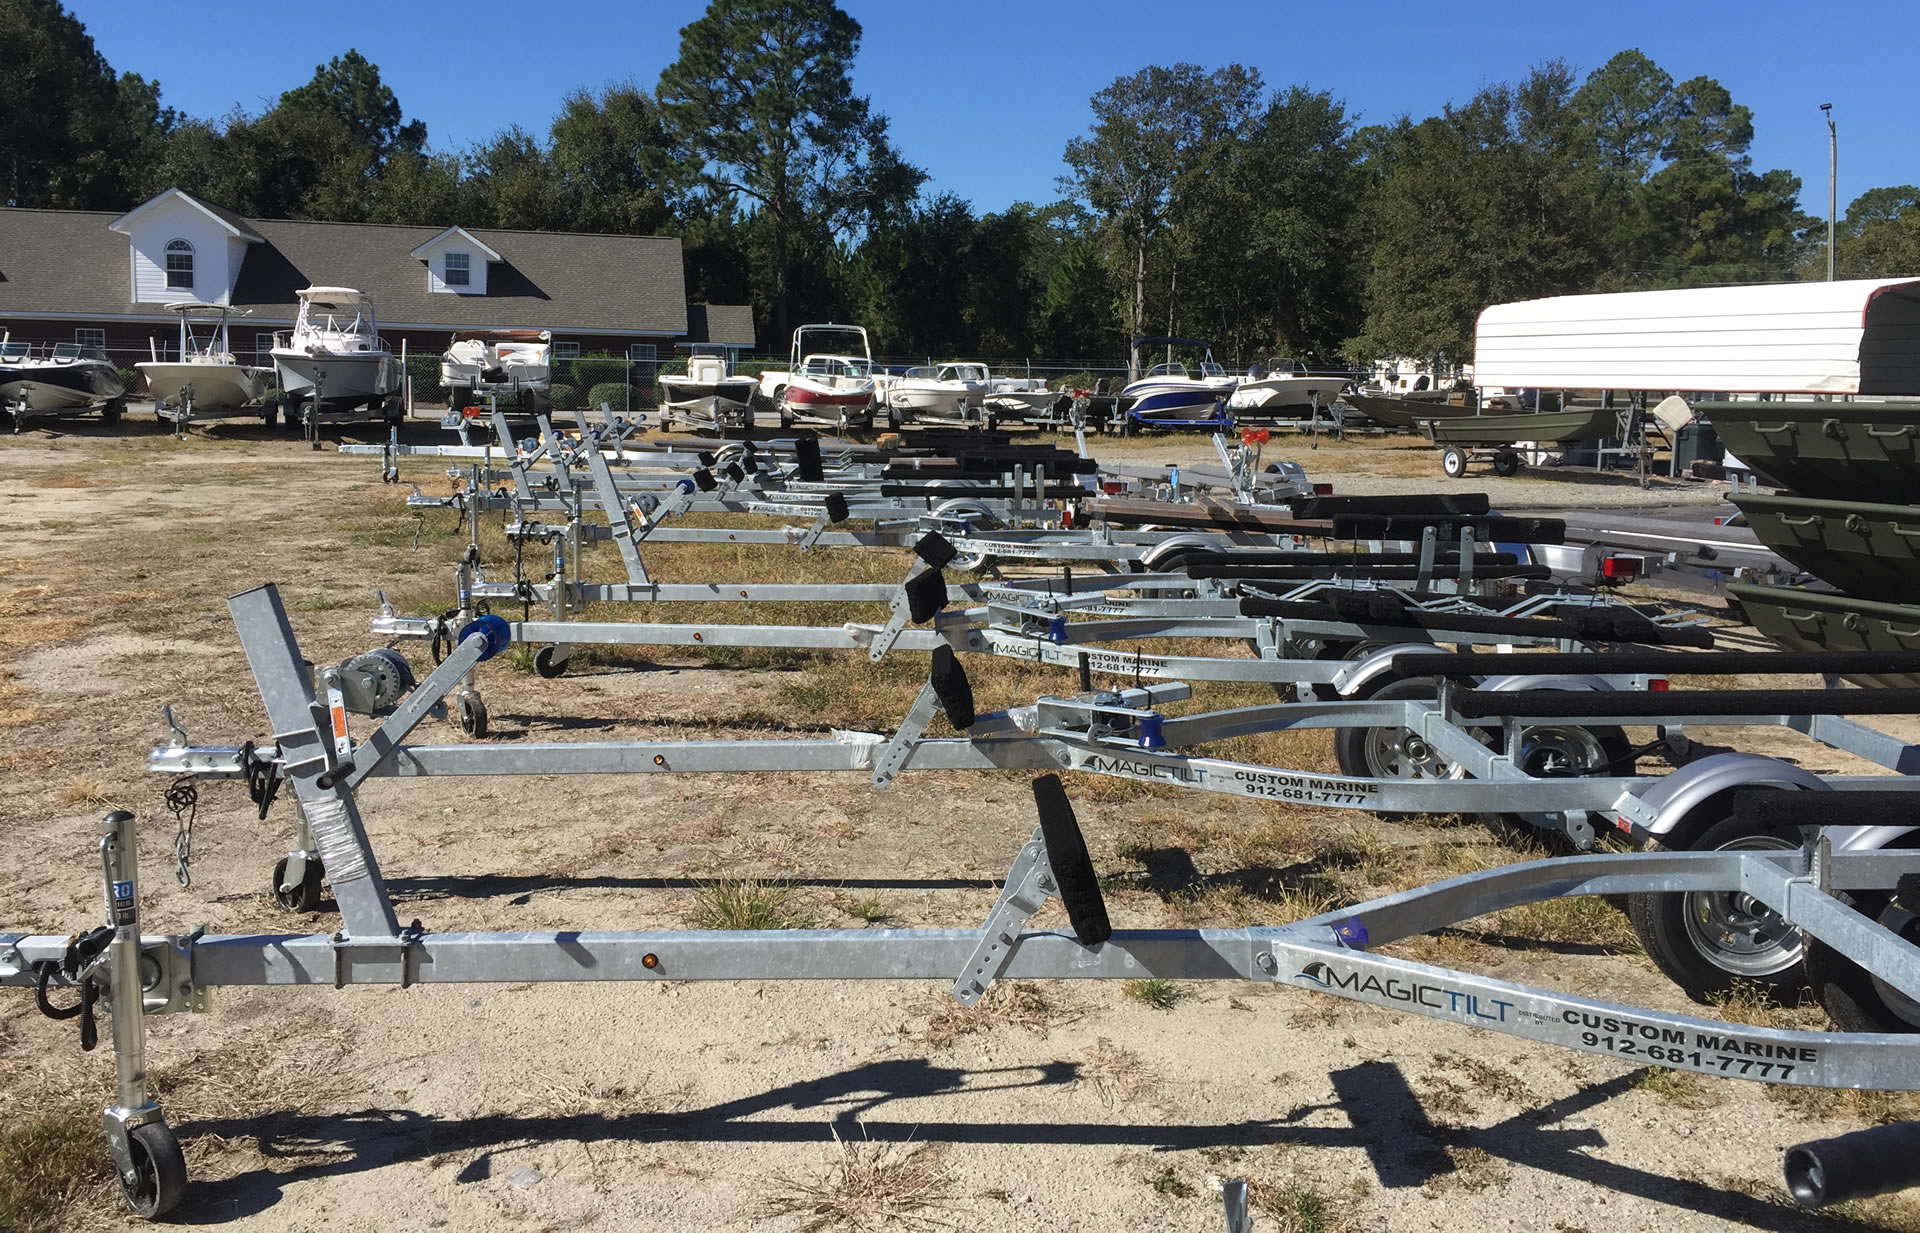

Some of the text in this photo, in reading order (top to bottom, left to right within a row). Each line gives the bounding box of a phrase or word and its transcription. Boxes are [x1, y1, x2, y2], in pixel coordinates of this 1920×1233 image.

[988, 548, 1036, 556] 912-681-7777
[1091, 661, 1160, 675] 12-681-7777
[1123, 657, 1168, 668] MARINE
[1098, 757, 1208, 783] MAGICTILT
[1234, 771, 1304, 788] CUSTOM
[1309, 779, 1379, 793] MARINE
[1245, 784, 1366, 804] 912-681-7777
[113, 884, 130, 898] RO
[1326, 965, 1514, 1022] MAGICTILT
[1518, 1009, 1561, 1024] DISTRIBUTED
[1562, 1010, 1817, 1063] CUSTOM MARINE
[1581, 1032, 1795, 1080] 912-681-7777
